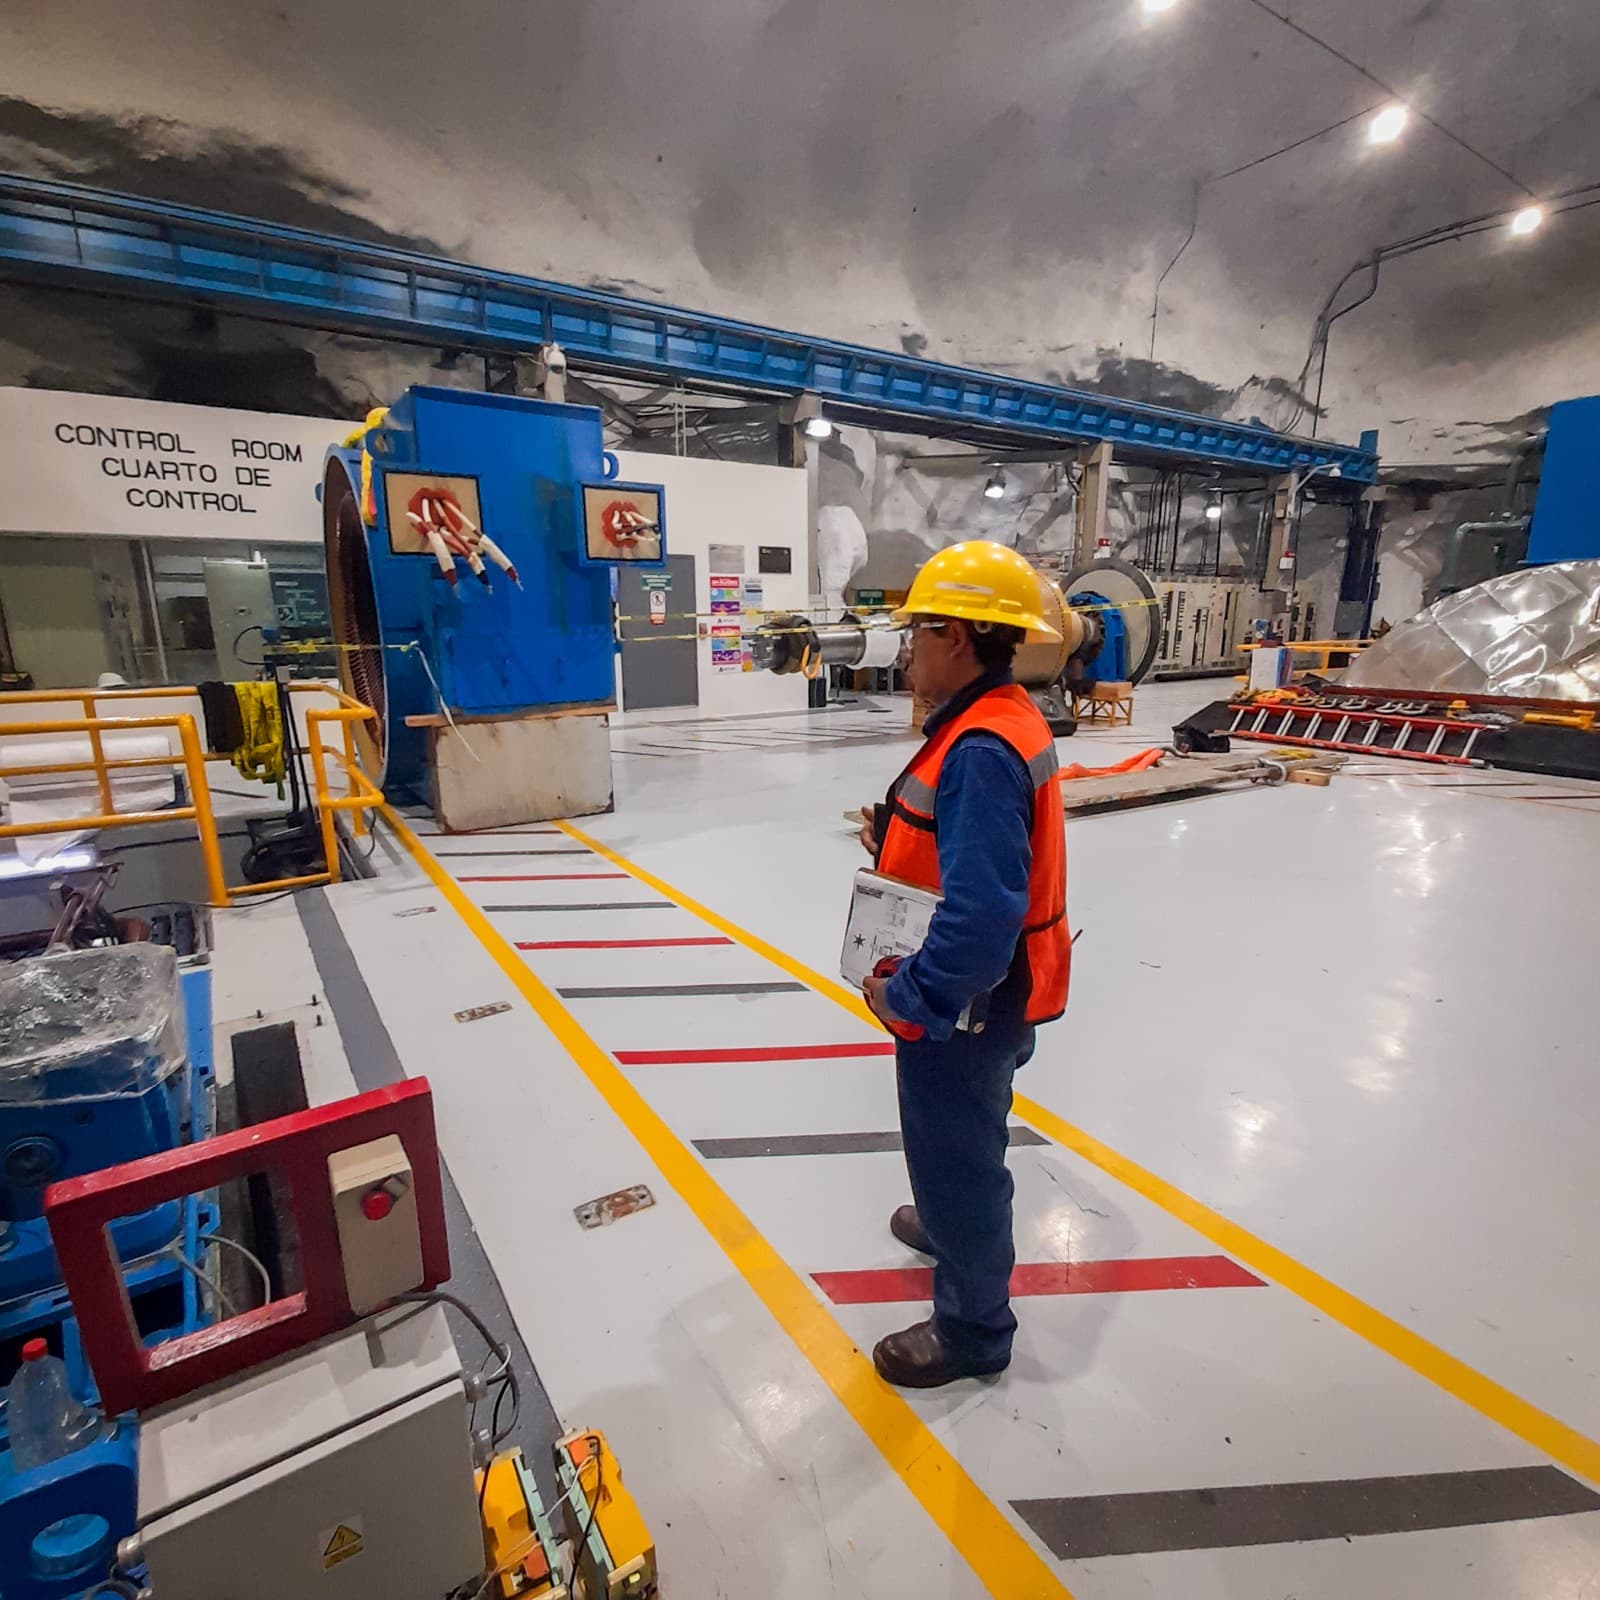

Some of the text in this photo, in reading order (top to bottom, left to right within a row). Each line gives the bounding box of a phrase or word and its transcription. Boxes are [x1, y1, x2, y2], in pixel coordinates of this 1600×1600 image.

[55, 423, 303, 463] CONTROL ROOM
[101, 457, 272, 487] CUARTO DE
[126, 488, 257, 513] CONTROL
